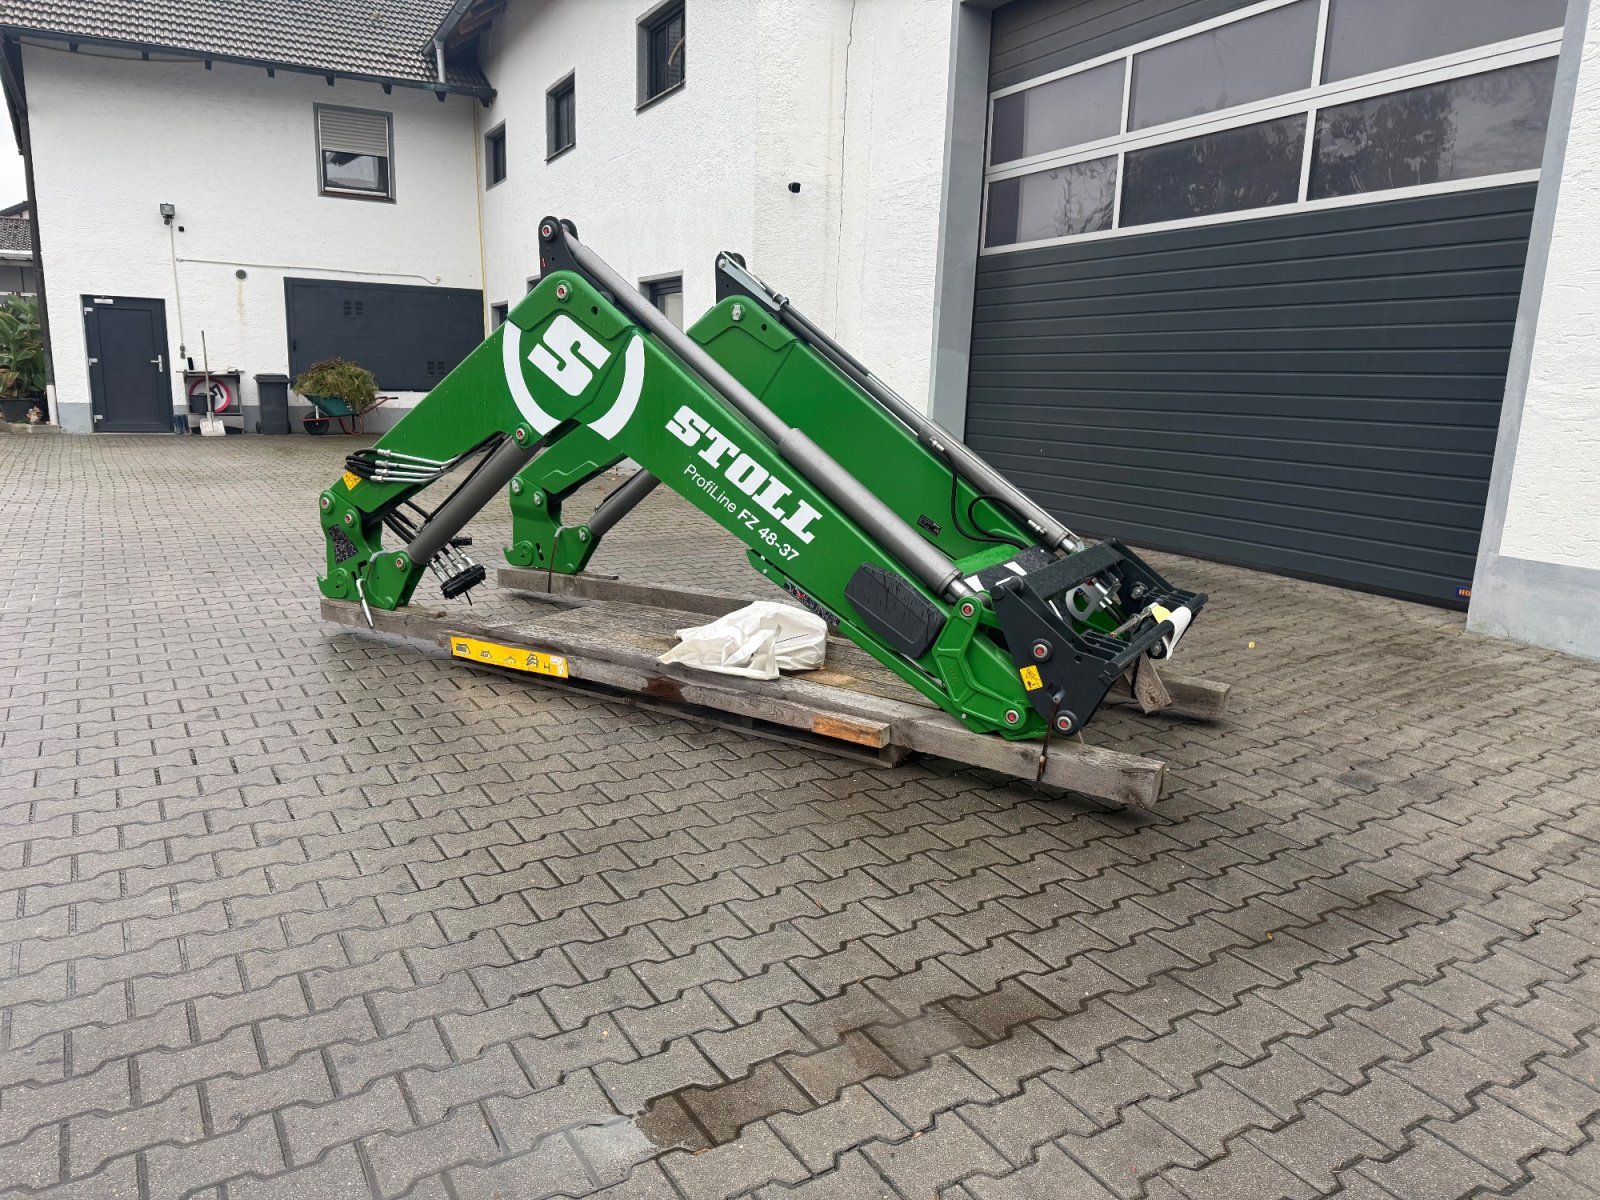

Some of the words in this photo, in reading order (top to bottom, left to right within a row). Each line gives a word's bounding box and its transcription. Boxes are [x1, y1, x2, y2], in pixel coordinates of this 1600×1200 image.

[527, 315, 611, 396] S
[665, 405, 823, 544] STOLL
[684, 464, 737, 513] ProfiLine
[737, 508, 760, 530] FZ
[758, 527, 799, 561] 48-37
